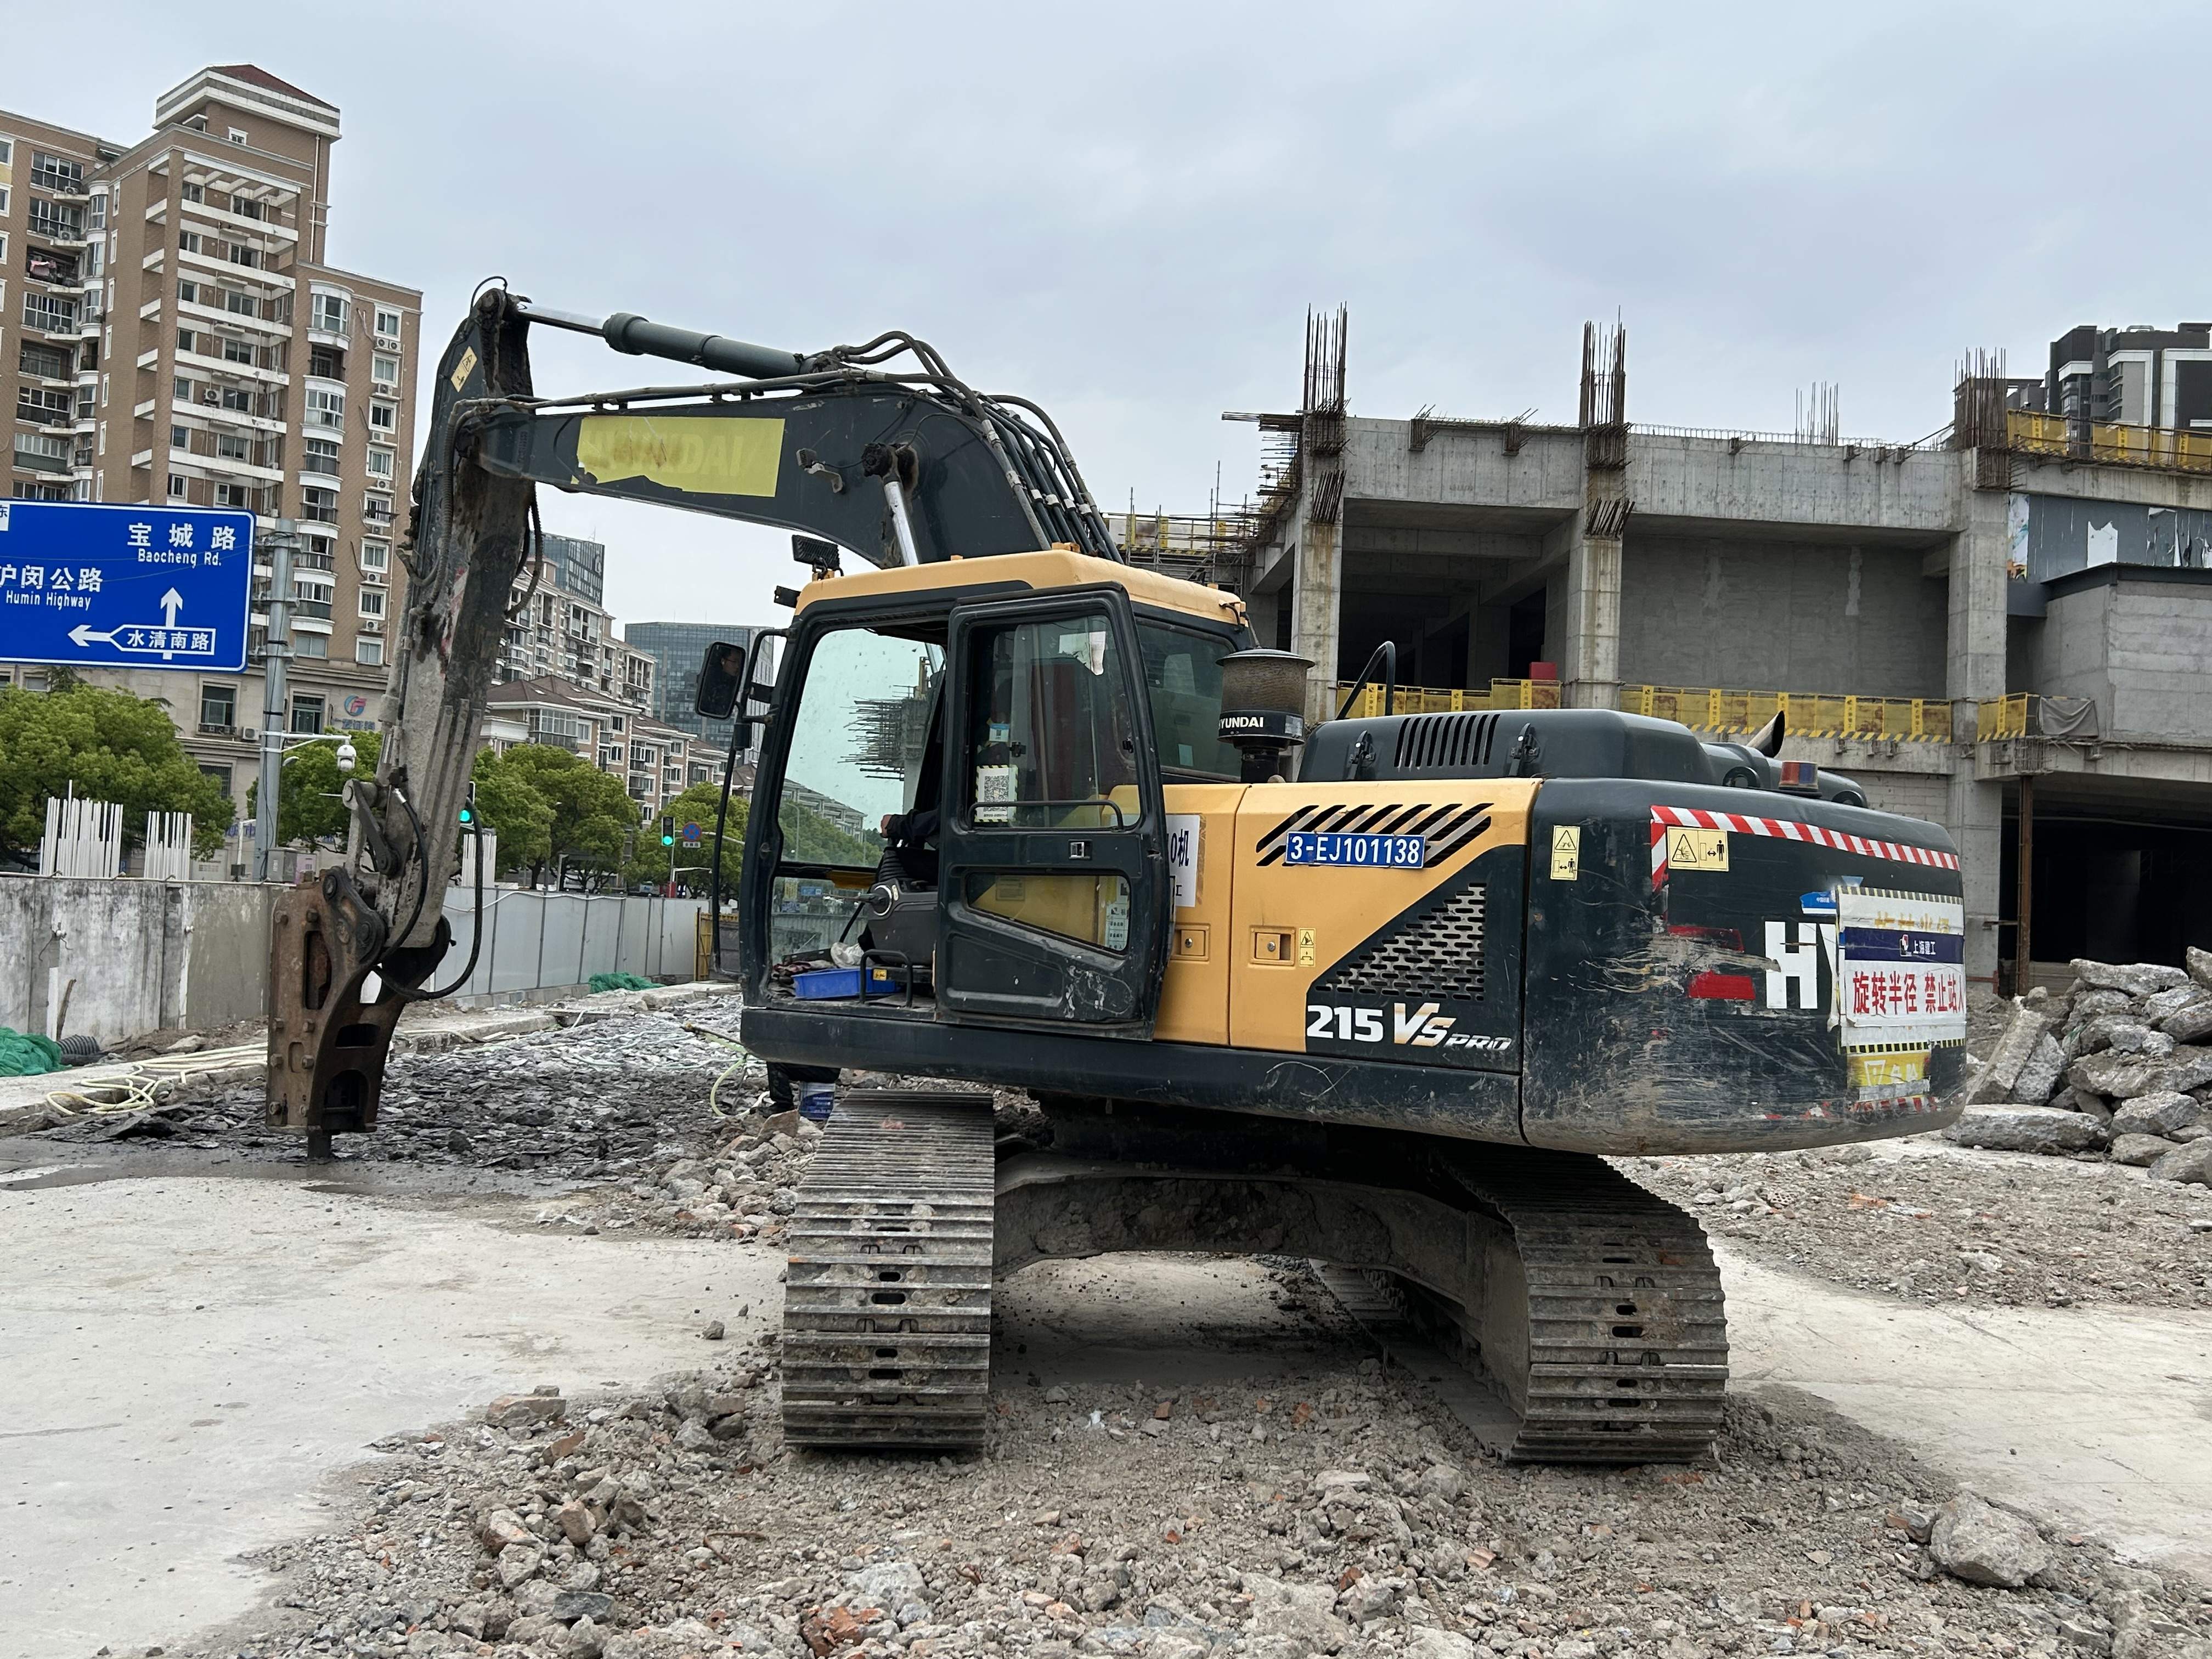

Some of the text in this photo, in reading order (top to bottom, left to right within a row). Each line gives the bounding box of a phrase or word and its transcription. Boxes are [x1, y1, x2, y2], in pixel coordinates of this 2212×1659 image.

[127, 522, 236, 550] 宝城路
[138, 548, 222, 568] Baocheng Rd.
[0, 564, 103, 592] 沪闵公路
[6, 590, 91, 611] Humin Highway
[127, 630, 209, 650] 水清南路
[1167, 828, 1189, 867] 0机
[1290, 836, 1420, 864] 3-EJ101138
[1852, 970, 1964, 1014] 旋转半径 禁止站人
[1307, 1005, 1384, 1042] 215
[1444, 1034, 1512, 1051] PRO
